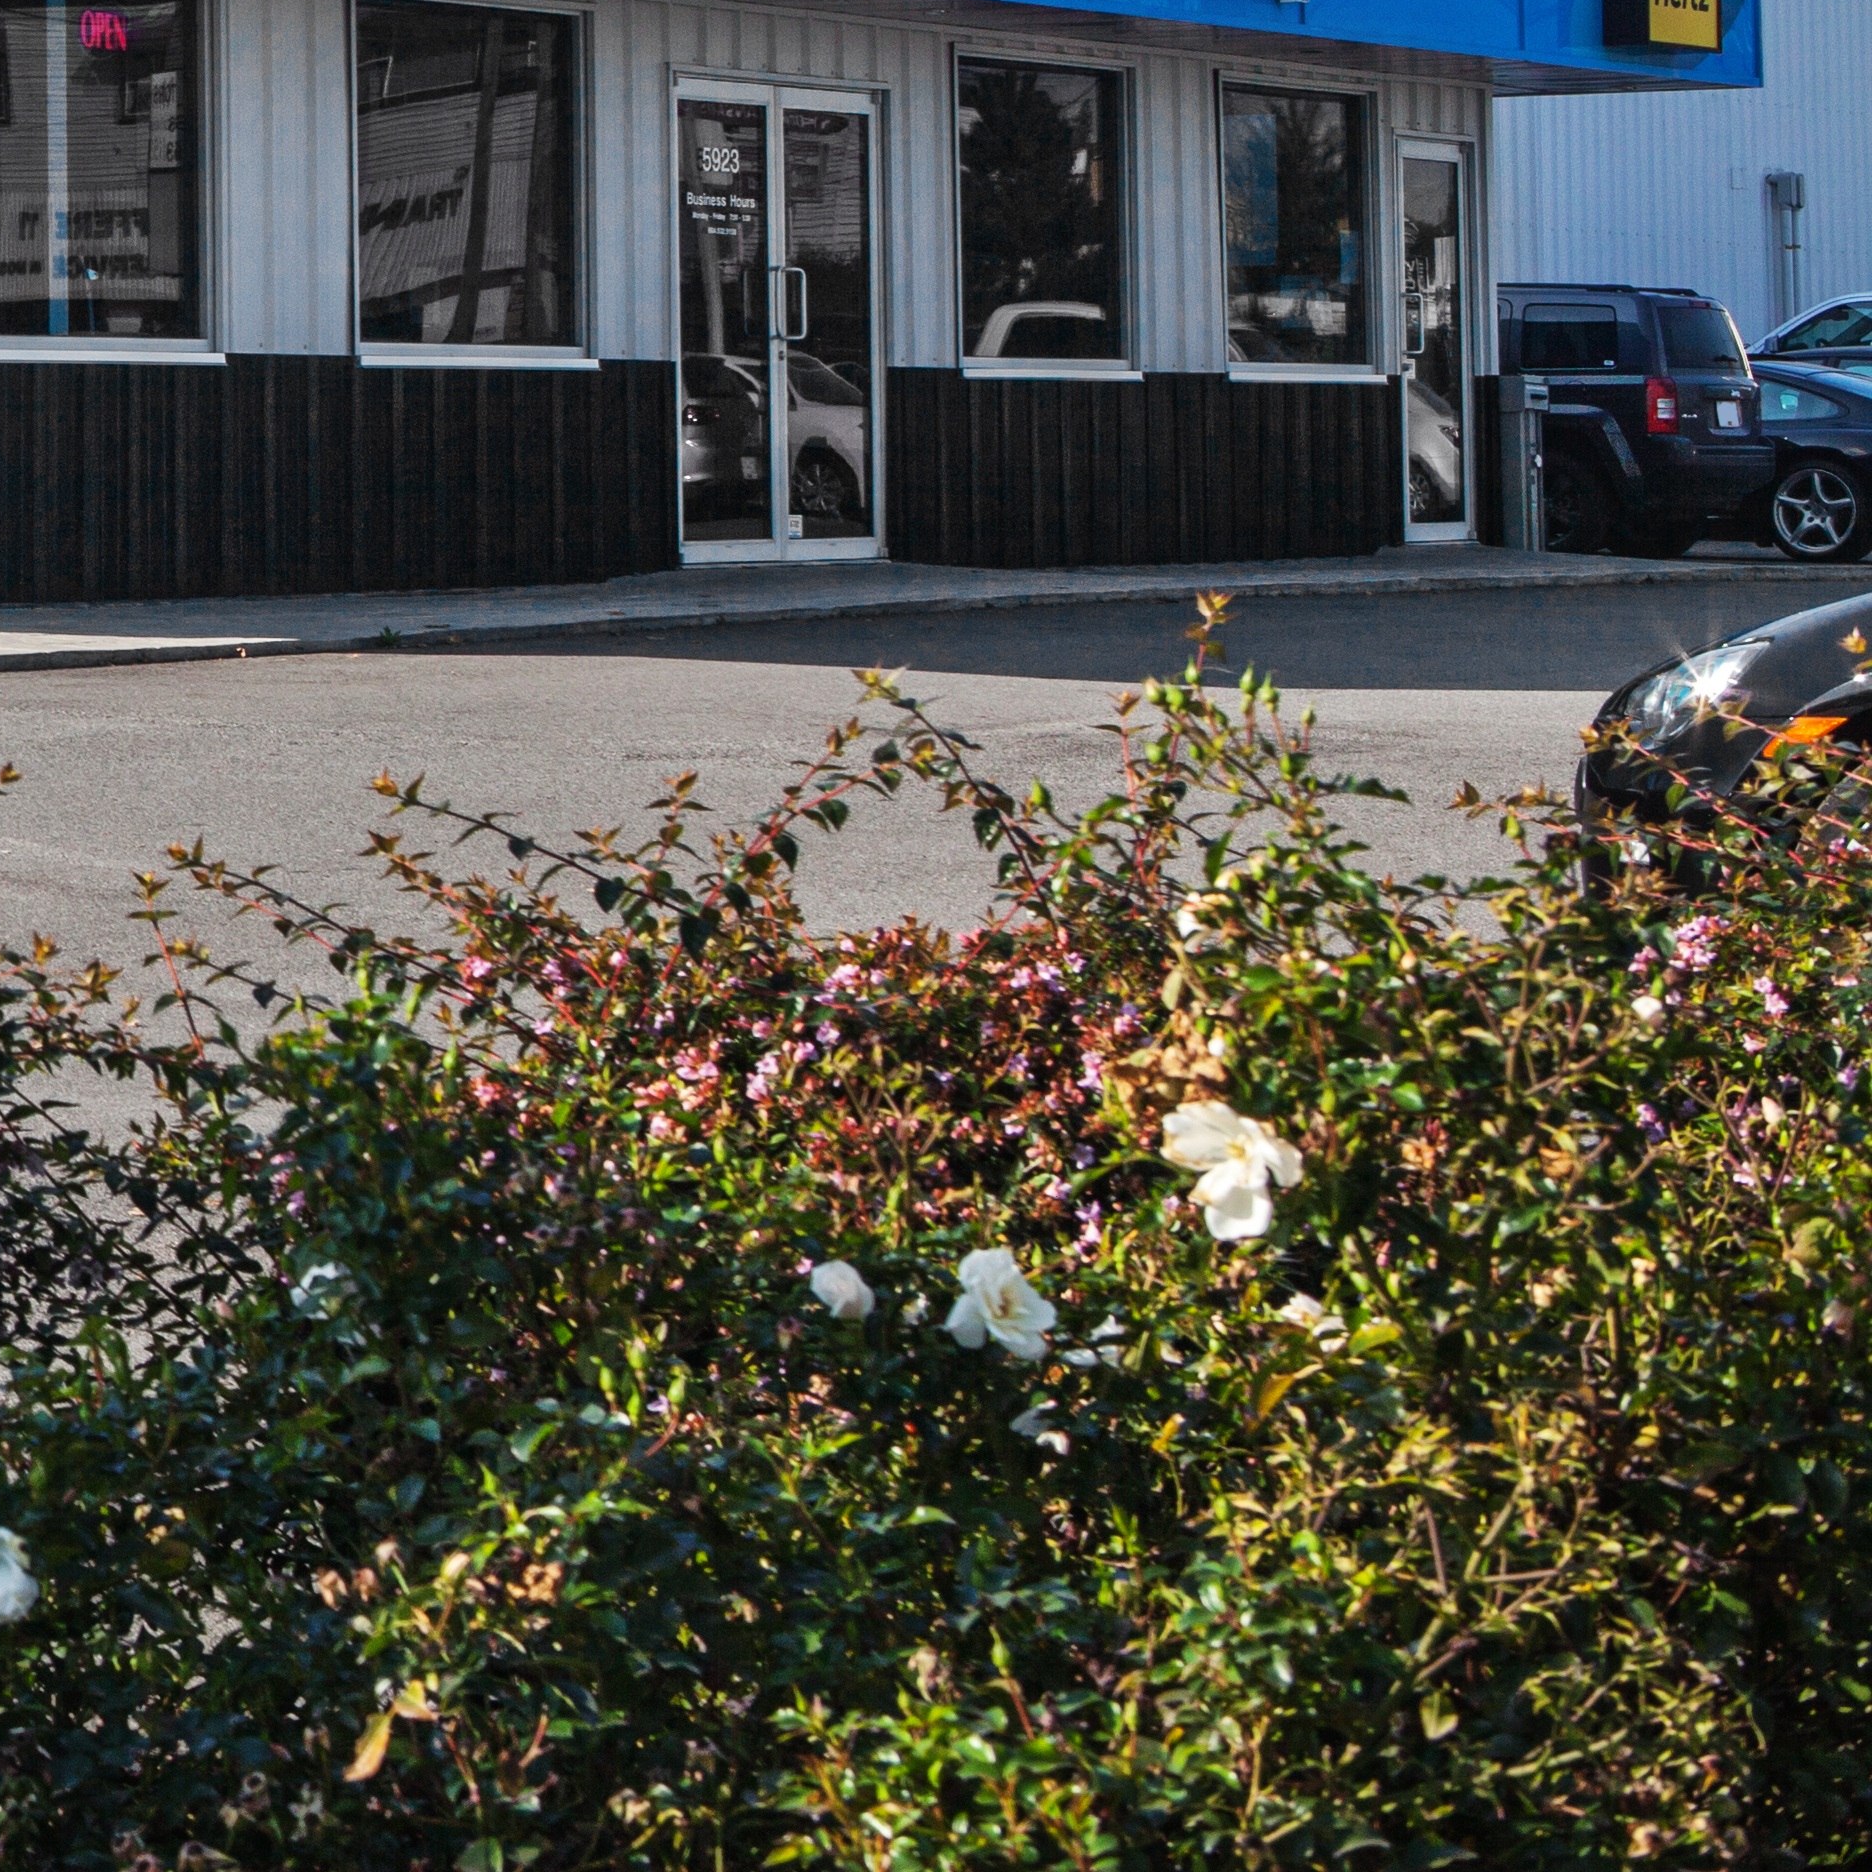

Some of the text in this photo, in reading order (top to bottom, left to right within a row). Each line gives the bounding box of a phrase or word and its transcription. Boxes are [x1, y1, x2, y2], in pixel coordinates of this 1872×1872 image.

[81, 10, 127, 51] OPEN
[702, 147, 740, 173] 5923
[686, 192, 756, 209] Business Hours
